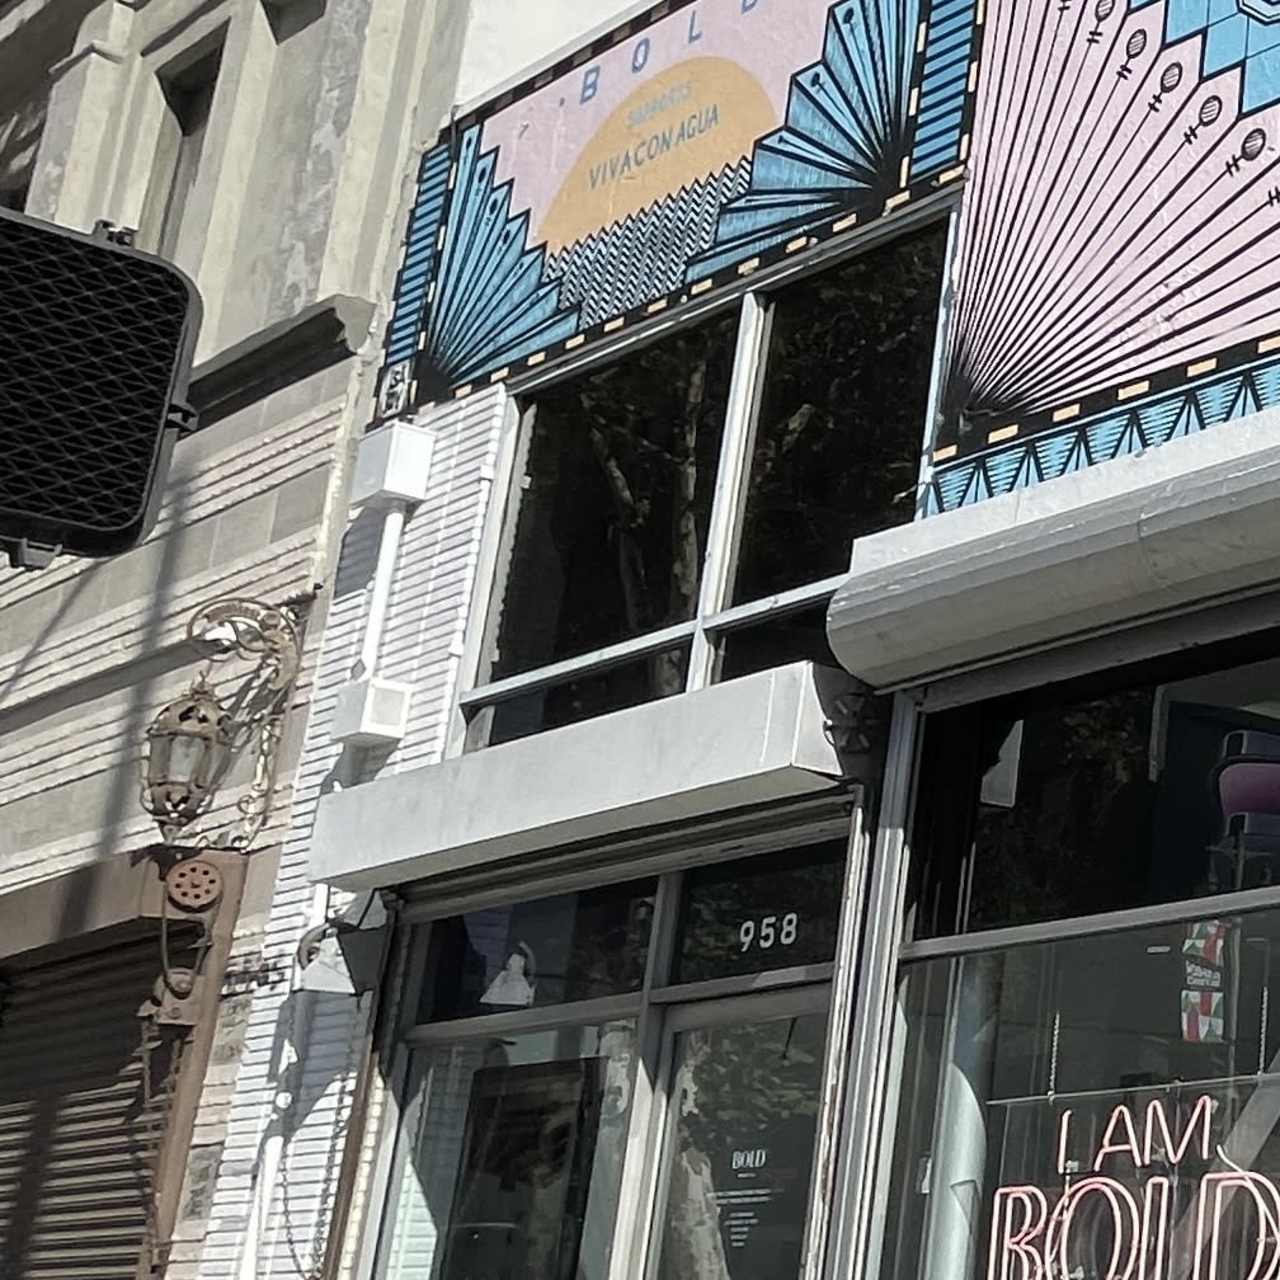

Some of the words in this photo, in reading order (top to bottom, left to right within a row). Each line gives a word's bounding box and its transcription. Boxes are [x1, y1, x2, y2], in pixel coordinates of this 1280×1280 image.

[675, 104, 719, 146] AGUA
[739, 913, 799, 953] 958
[1056, 1108, 1074, 1175] I
[1093, 1094, 1217, 1172] AM
[731, 1149, 767, 1170] BOLD
